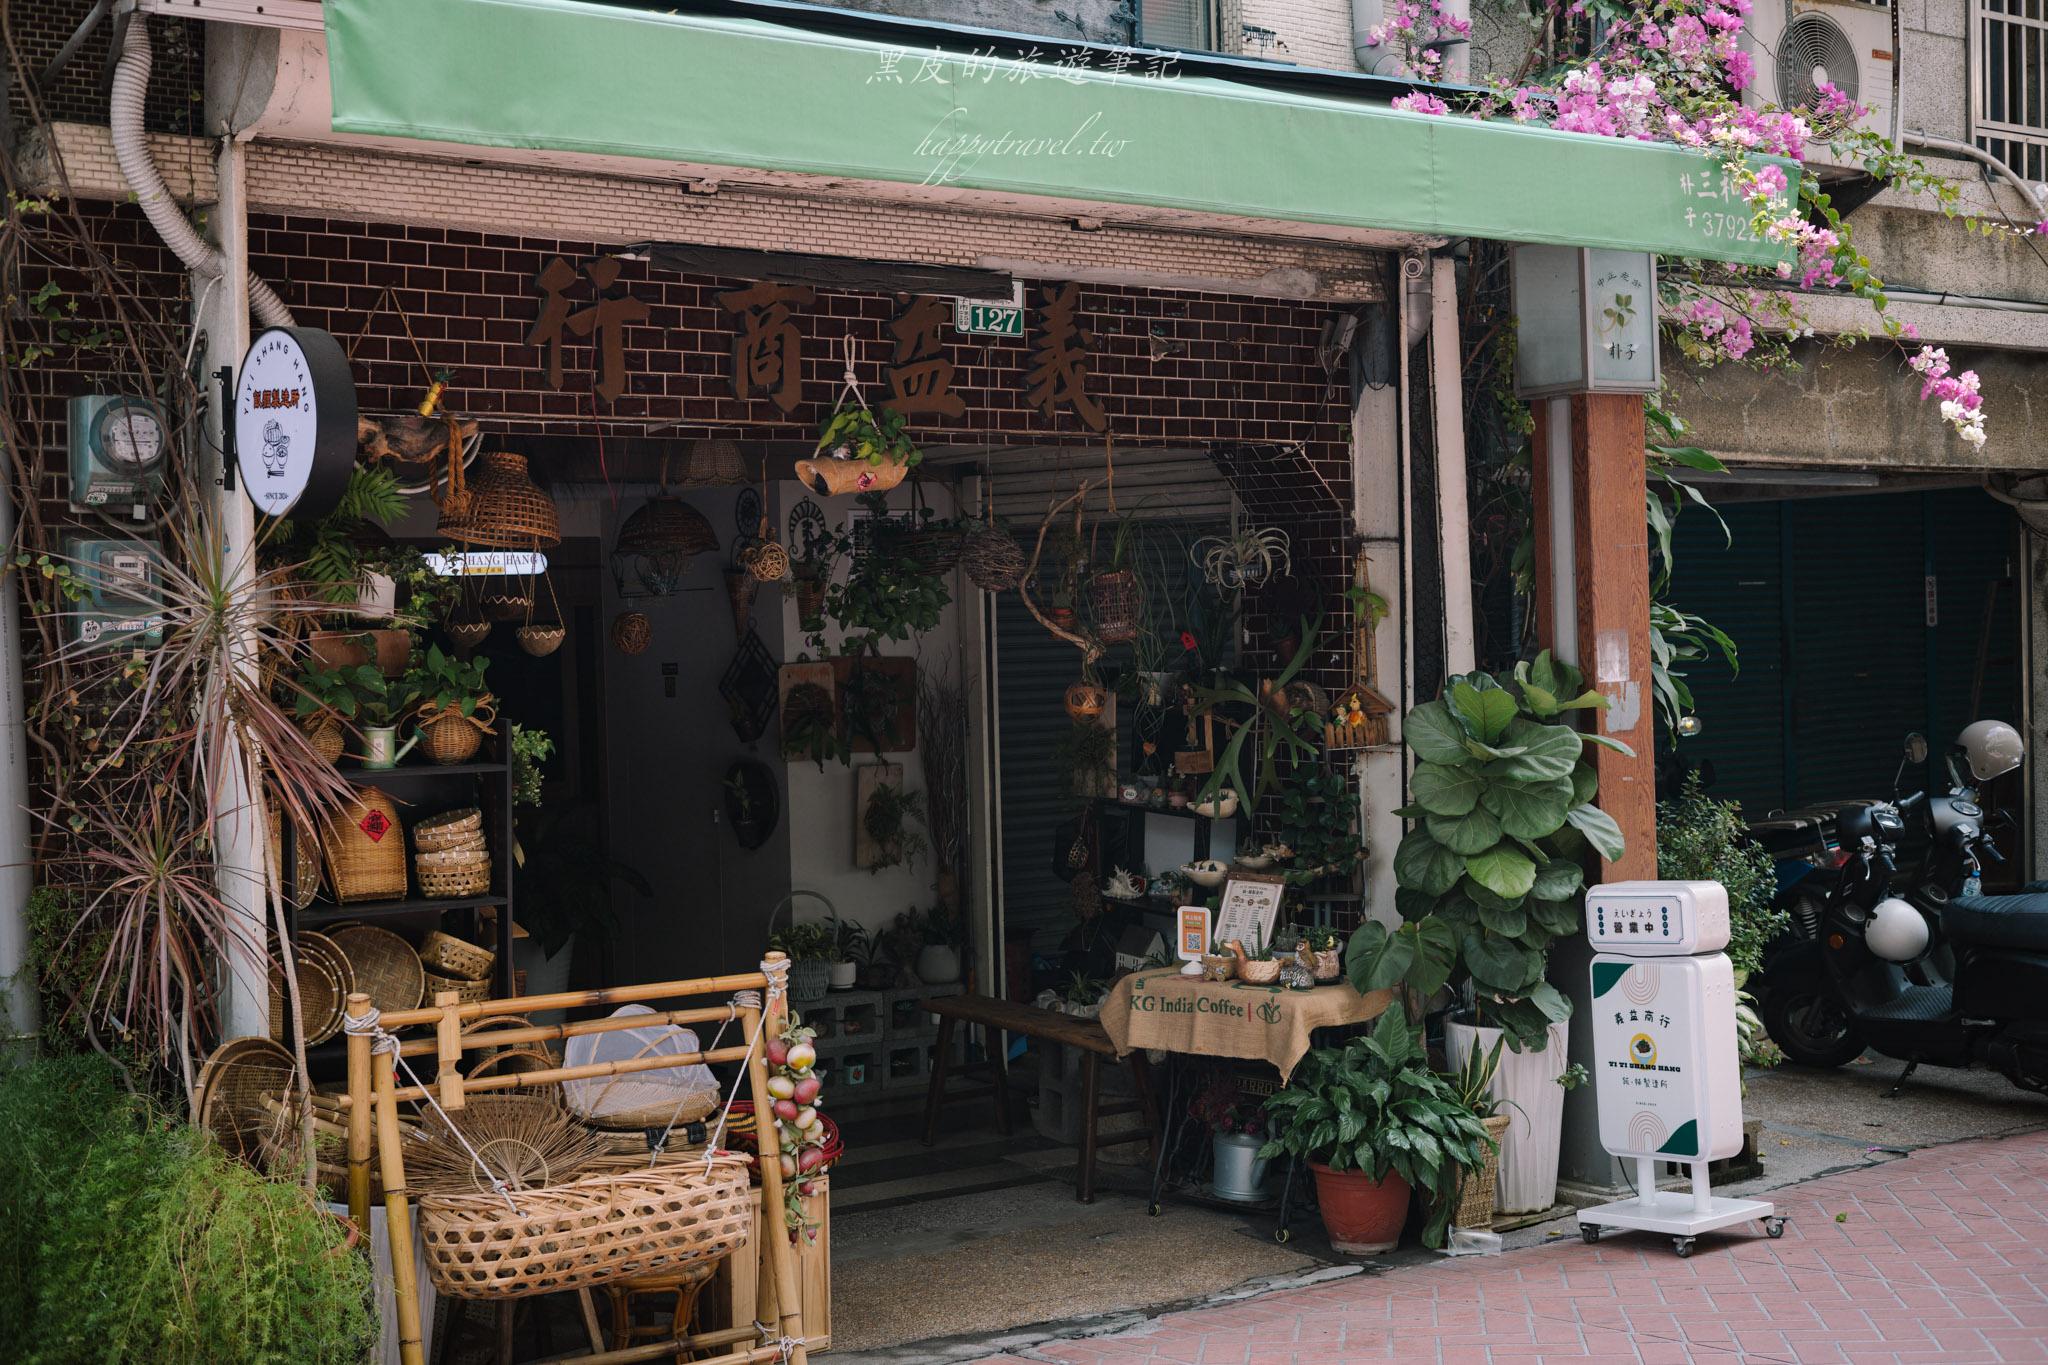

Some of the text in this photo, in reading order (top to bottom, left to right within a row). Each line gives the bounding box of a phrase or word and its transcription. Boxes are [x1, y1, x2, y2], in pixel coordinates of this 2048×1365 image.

[975, 307, 1018, 333] 127
[256, 340, 289, 366] SHANG
[293, 358, 309, 413] HANG
[1129, 995, 1244, 1017] KG India Coffee
[1658, 1065, 1681, 1073] HANG
